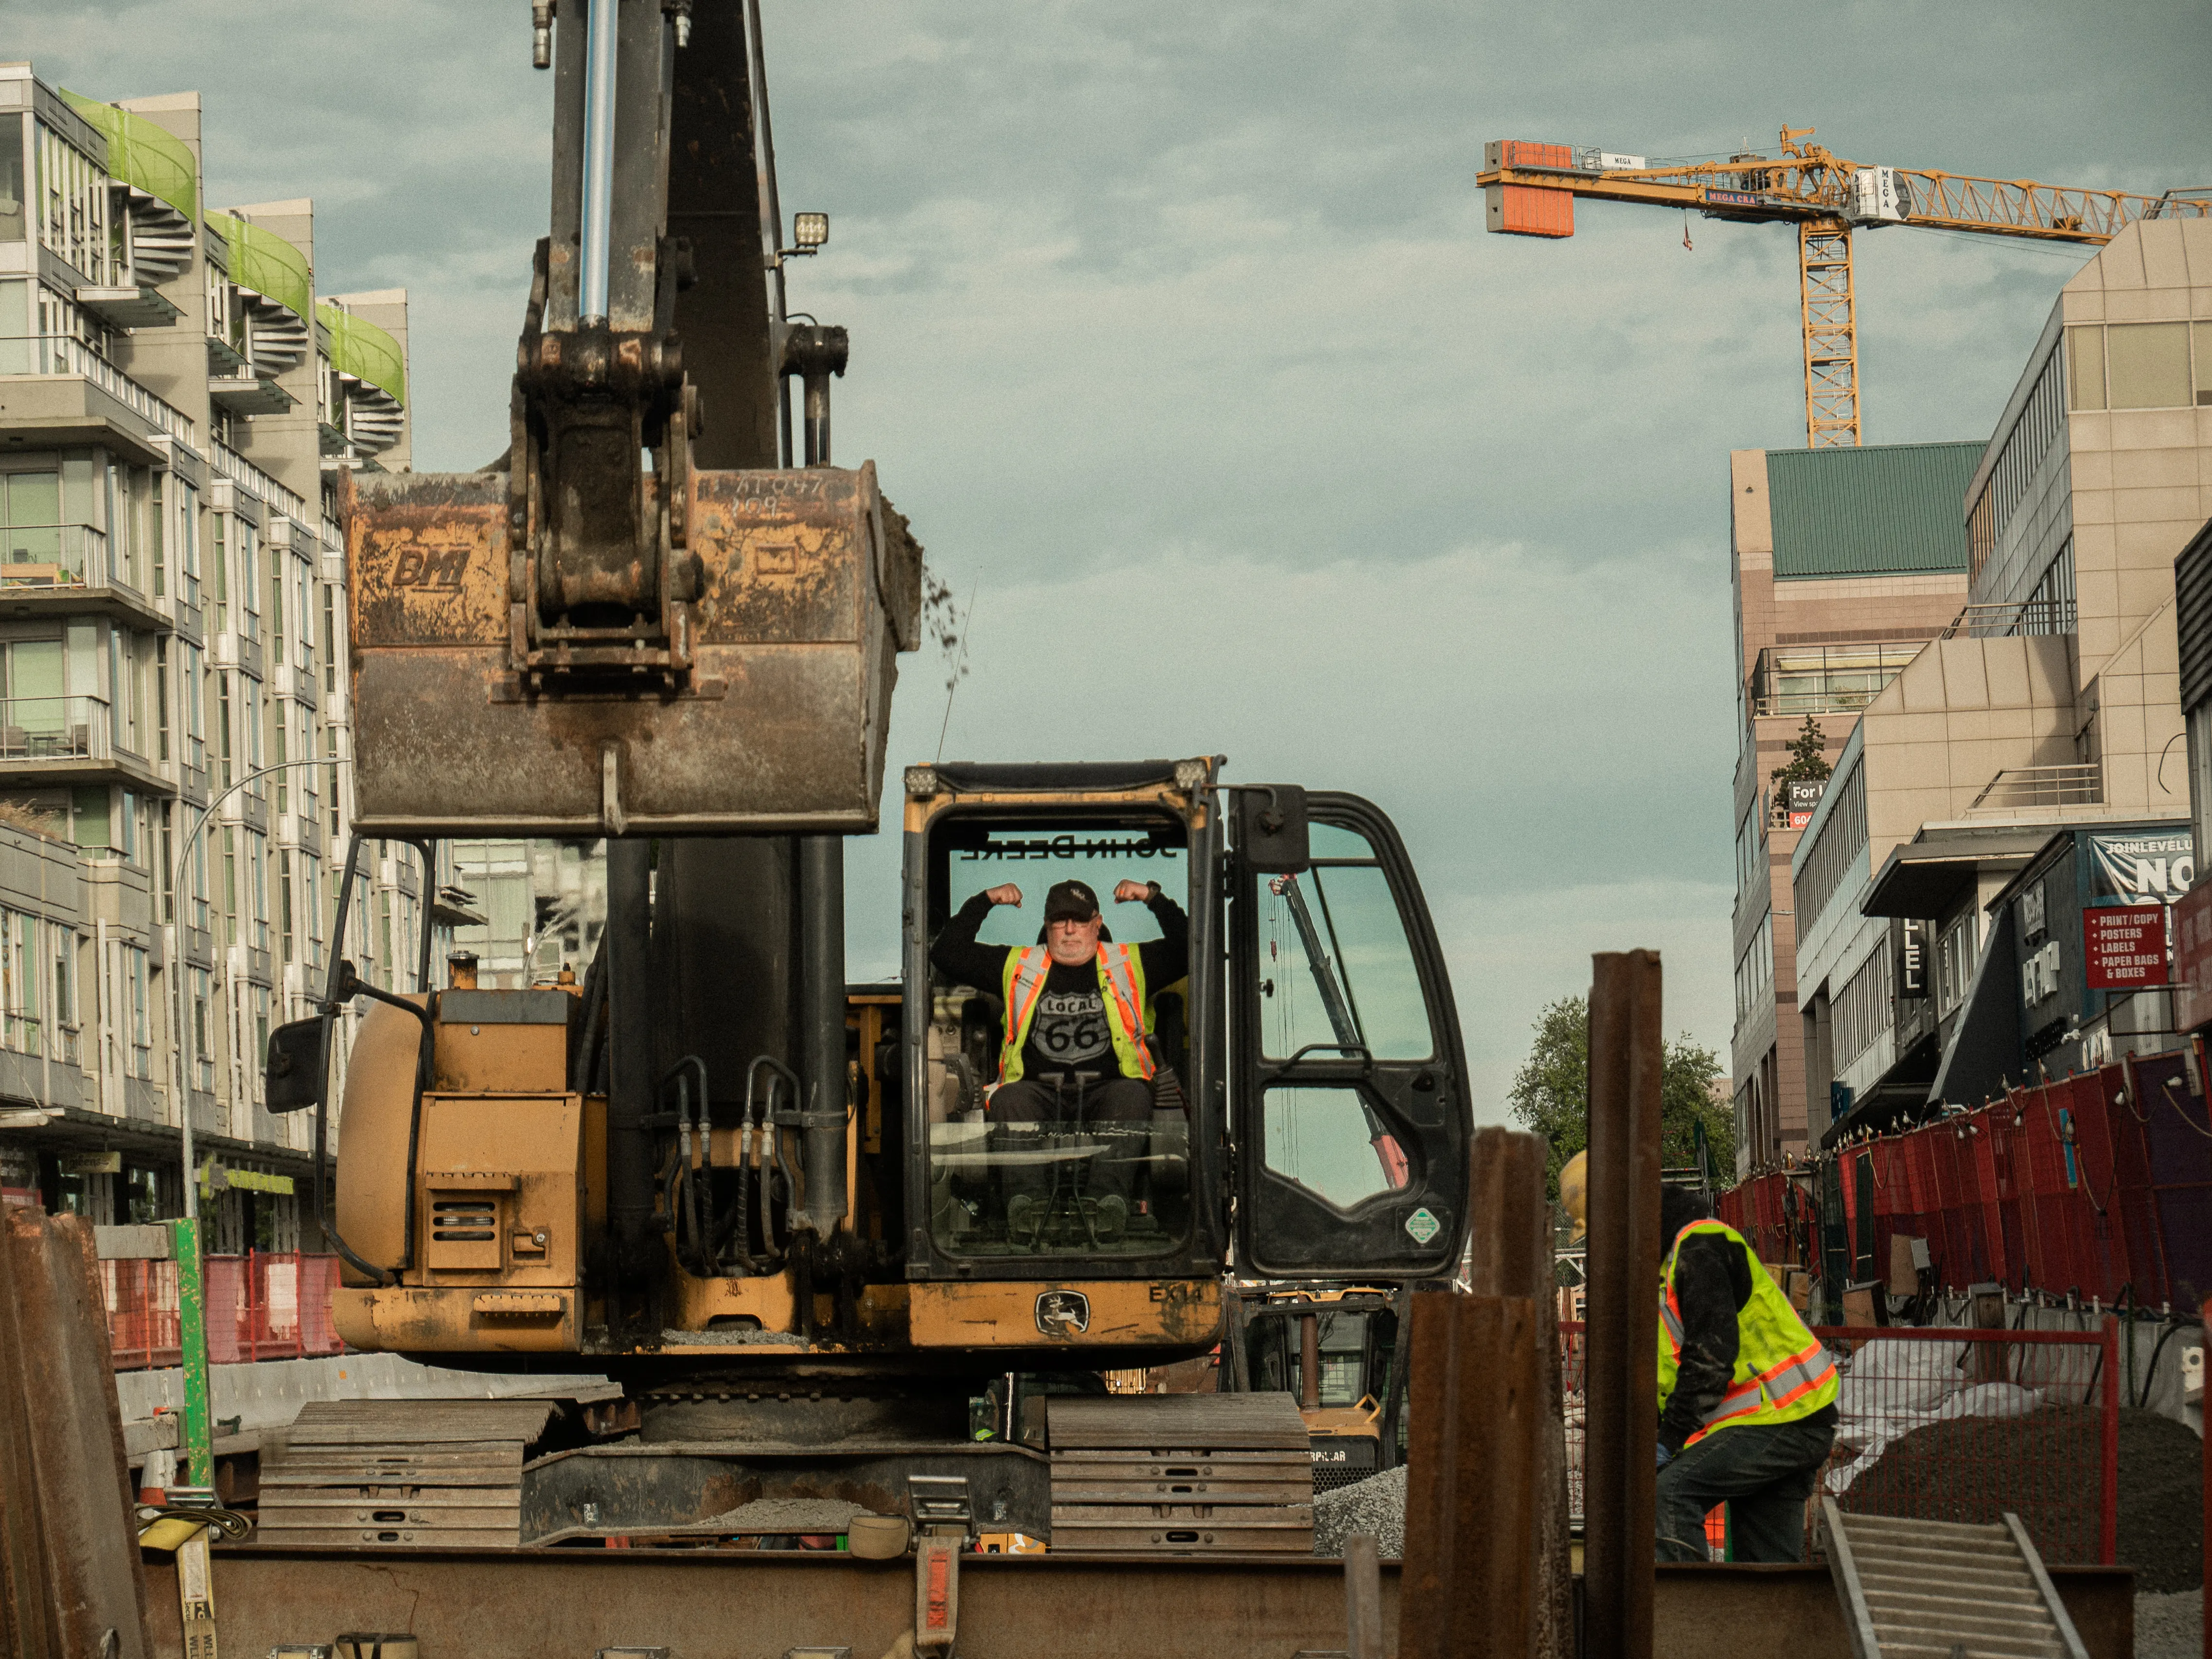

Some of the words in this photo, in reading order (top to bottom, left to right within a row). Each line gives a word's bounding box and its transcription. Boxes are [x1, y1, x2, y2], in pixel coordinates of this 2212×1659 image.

[1709, 192, 1734, 202] MEGA
[392, 549, 471, 586] BMI
[1793, 786, 1816, 799] For
[2101, 928, 2142, 940] POSTERS
[2101, 942, 2135, 953] LABELS
[2102, 955, 2132, 967] PAPER
[2134, 954, 2159, 966] BAGS
[2107, 969, 2113, 979] &
[2116, 967, 2145, 979] BOXES
[1047, 998, 1096, 1013] LOCAL
[1045, 1019, 1099, 1053] 66
